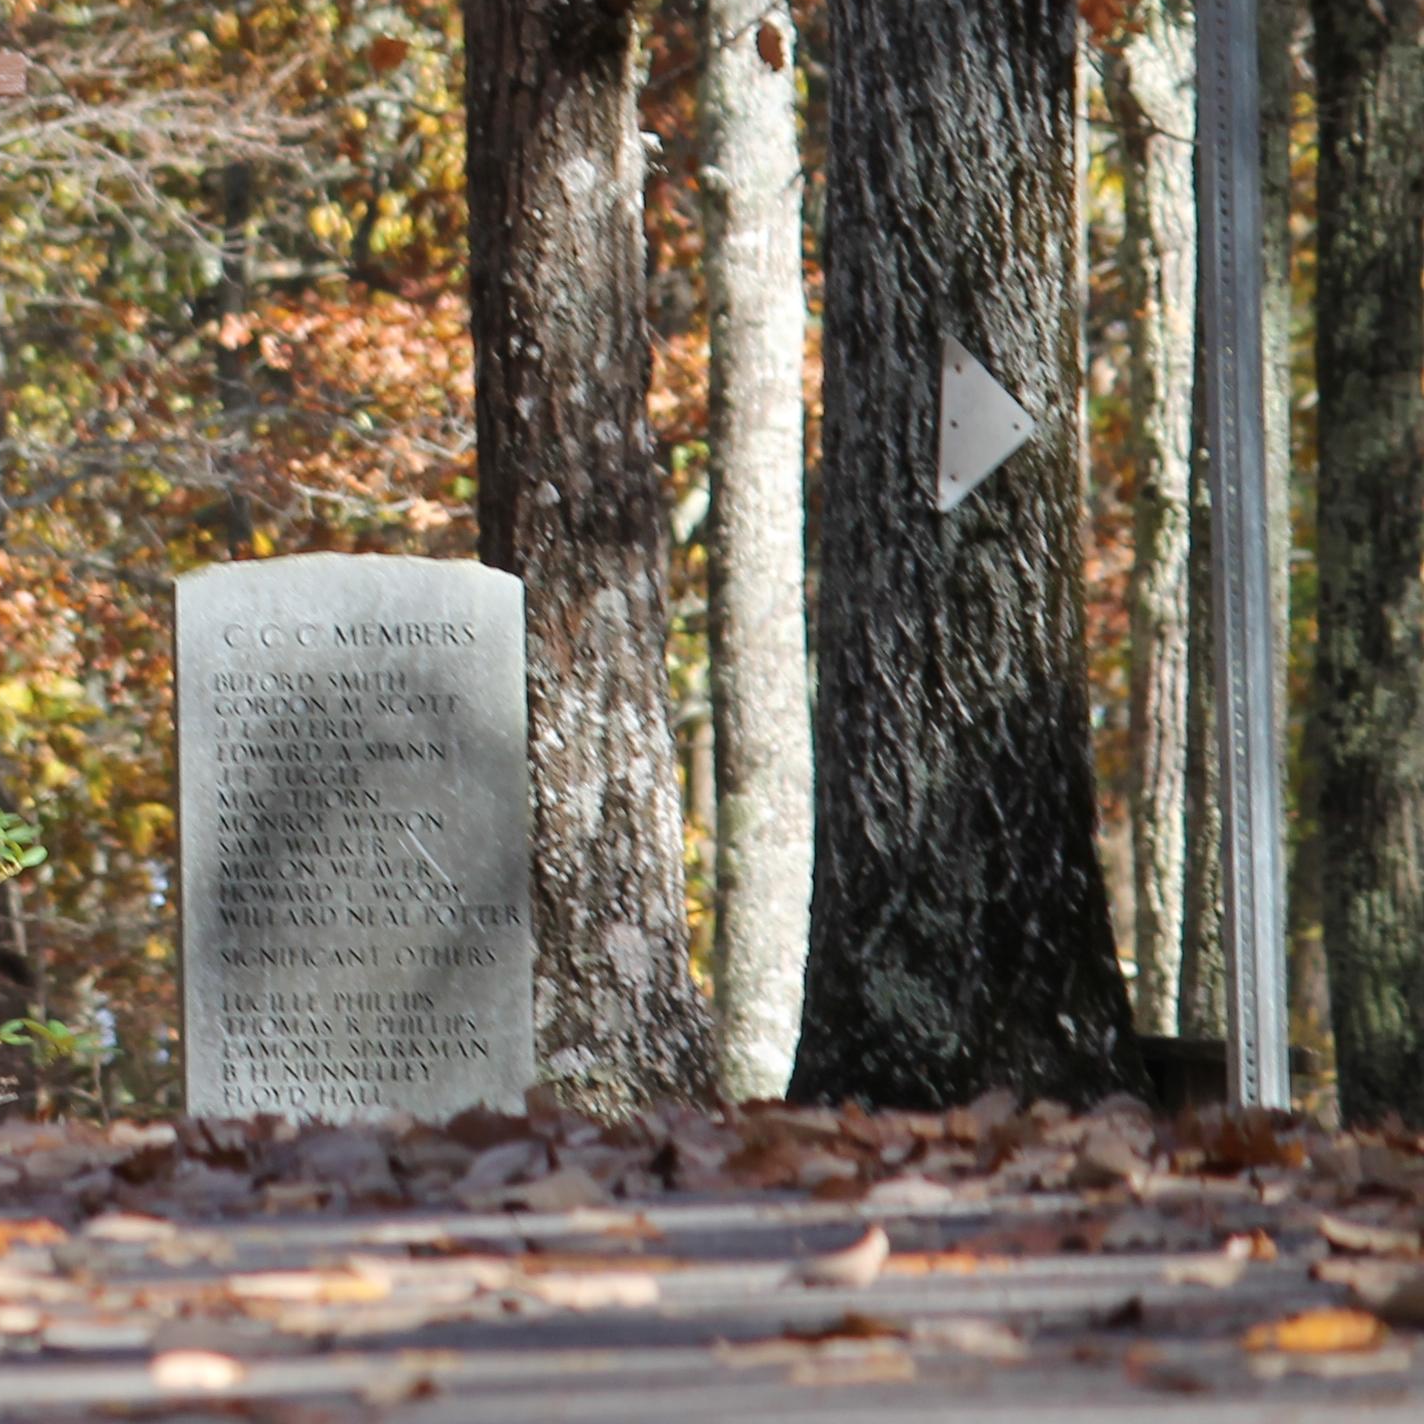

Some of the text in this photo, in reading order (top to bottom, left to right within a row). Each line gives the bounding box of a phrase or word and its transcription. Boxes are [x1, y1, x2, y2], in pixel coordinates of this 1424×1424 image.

[333, 621, 477, 647] MEMBERS
[214, 671, 408, 694] BUFORD SMITH
[214, 694, 461, 717] GORDON M SCOTT
[216, 741, 449, 764] EDWARD A SPANN
[268, 764, 364, 787] TUGGLE
[217, 789, 382, 810] MAC THORN
[218, 811, 445, 834] MONROE WATSON
[218, 835, 389, 857] SAM WALKER
[330, 858, 433, 881] WEAVER
[218, 882, 334, 904] HOWARD
[371, 881, 465, 904] WOODY
[219, 904, 523, 927] WILLARD NEAL POTTER
[220, 945, 498, 968] SIGNIFICANT OTHERS
[222, 991, 436, 1013] LUCILLE PHILLIPS
[223, 1017, 333, 1038] THOMAS
[375, 1015, 478, 1036] PHILLIPS
[223, 1038, 490, 1060] LAMONT SPARKMAN
[250, 1062, 269, 1082] H
[283, 1061, 433, 1083] NUNNELLEY
[223, 1084, 383, 1108] FLOYD HALL
